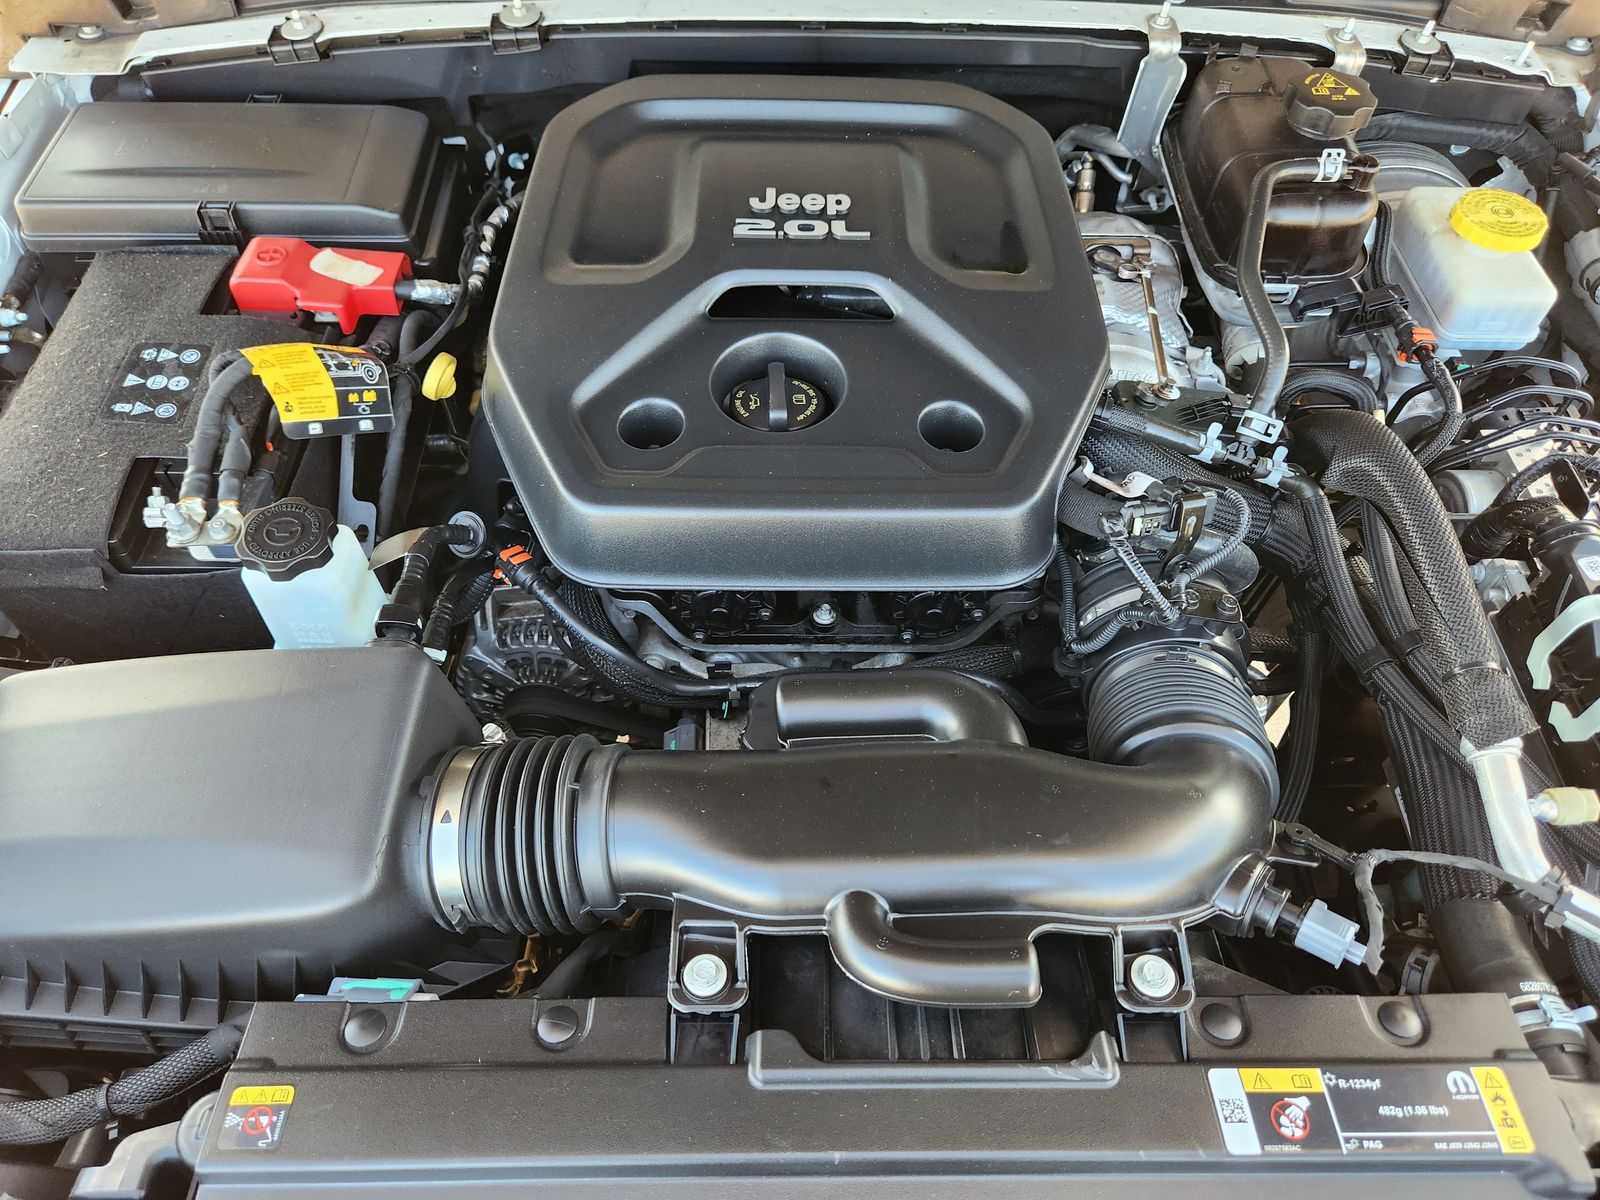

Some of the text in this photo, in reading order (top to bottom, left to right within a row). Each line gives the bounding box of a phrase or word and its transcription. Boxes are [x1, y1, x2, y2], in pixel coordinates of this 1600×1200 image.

[749, 187, 851, 218] Jeep
[733, 218, 871, 240] 2.0L
[734, 389, 750, 418] ENGINE OIL
[247, 504, 320, 533] POWER STEERING FLUID
[249, 541, 311, 559] USE APPROVED
[1338, 1079, 1381, 1090] R-1234yf
[1378, 1105, 1403, 1118] 482g
[1428, 1105, 1448, 1118] lbs)
[1362, 1140, 1383, 1149] PAG
